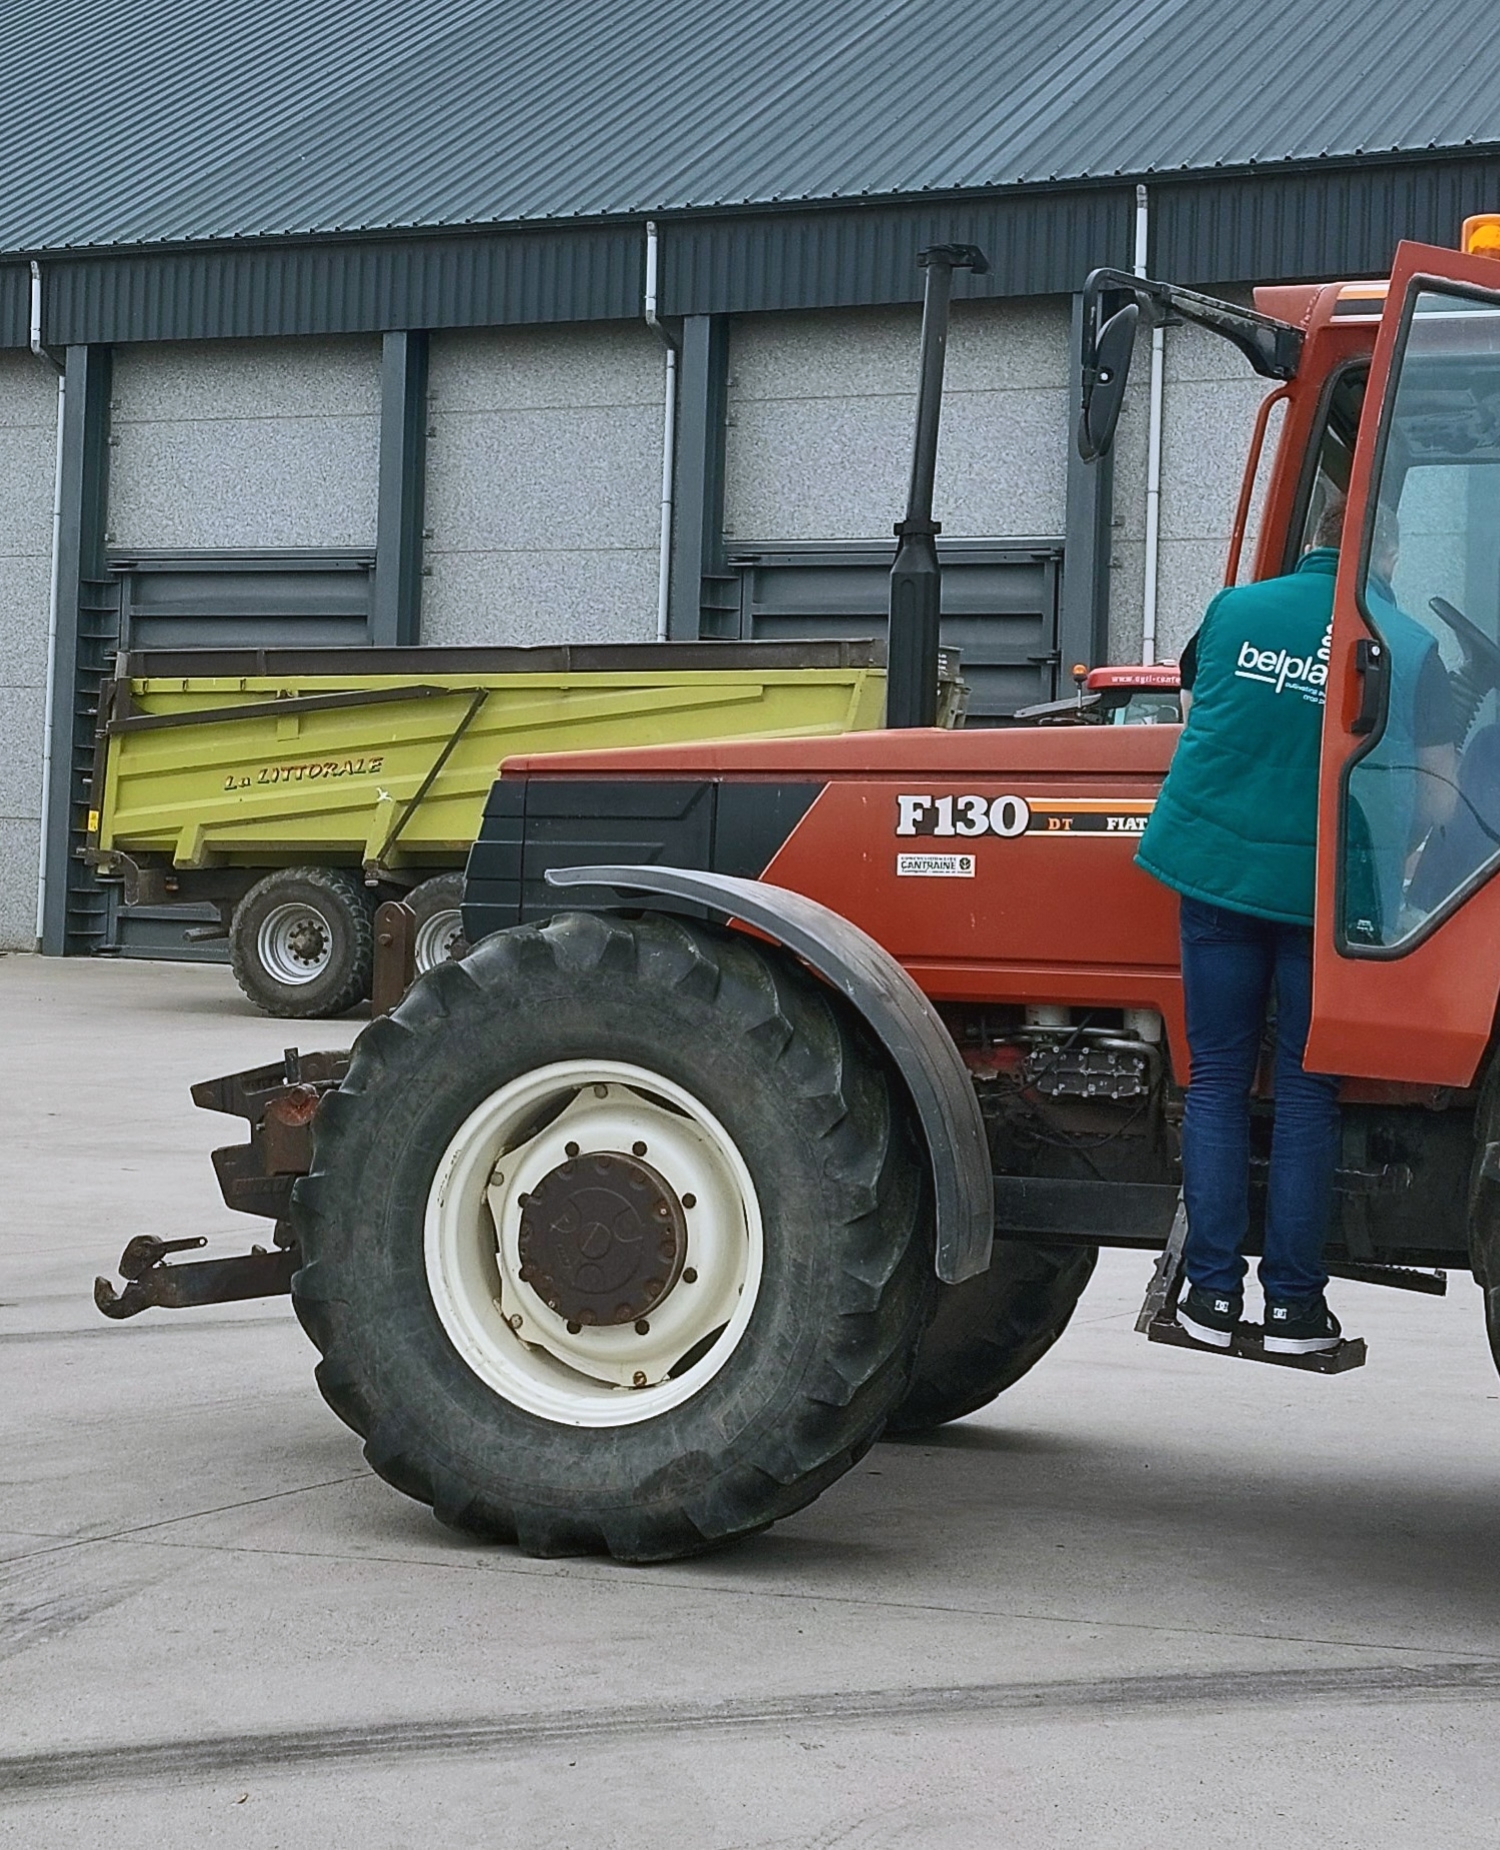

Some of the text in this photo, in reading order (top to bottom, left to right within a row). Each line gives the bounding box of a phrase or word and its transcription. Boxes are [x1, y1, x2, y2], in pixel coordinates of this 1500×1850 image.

[1237, 641, 1330, 694] belpla
[257, 757, 385, 784] LITTORALE
[896, 795, 1030, 837] F130
[1048, 817, 1148, 831] DT FIAT
[900, 861, 957, 870] CANTRAINE
